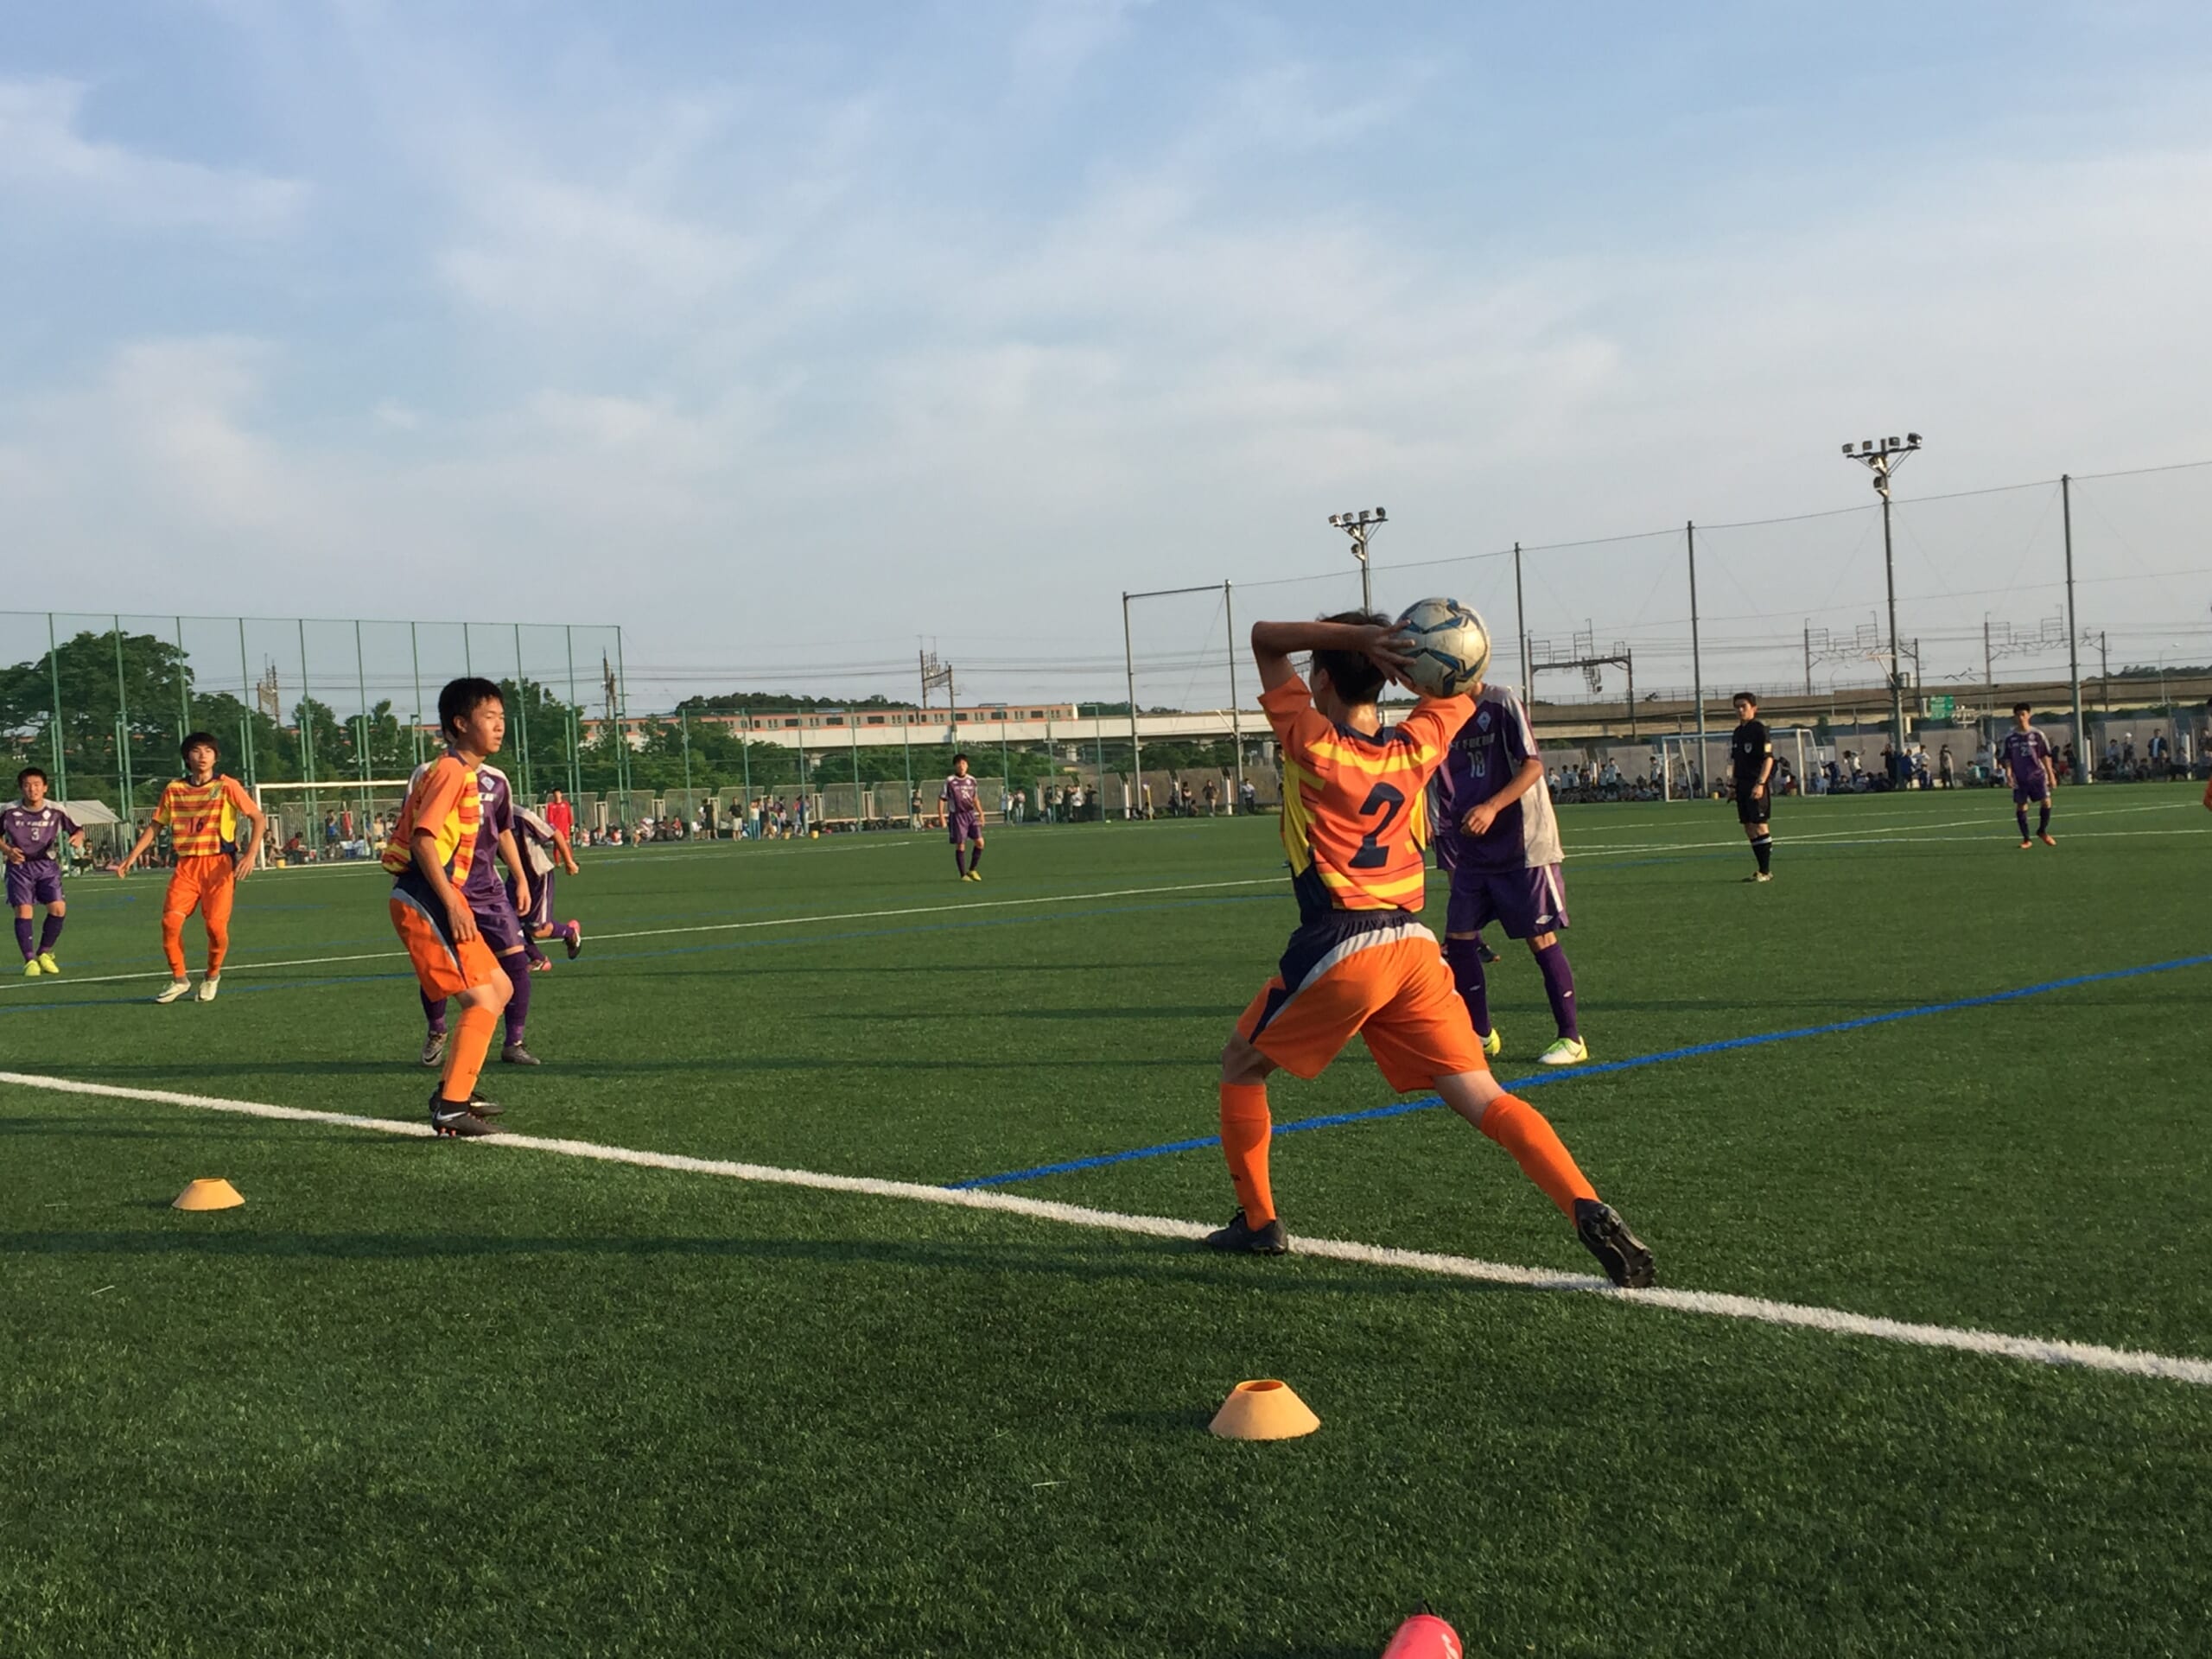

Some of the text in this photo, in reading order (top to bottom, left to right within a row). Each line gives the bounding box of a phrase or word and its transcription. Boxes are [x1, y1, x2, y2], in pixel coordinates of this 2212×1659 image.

[31, 827, 40, 841] 3
[190, 816, 205, 834] 16
[1348, 782, 1405, 868] 2
